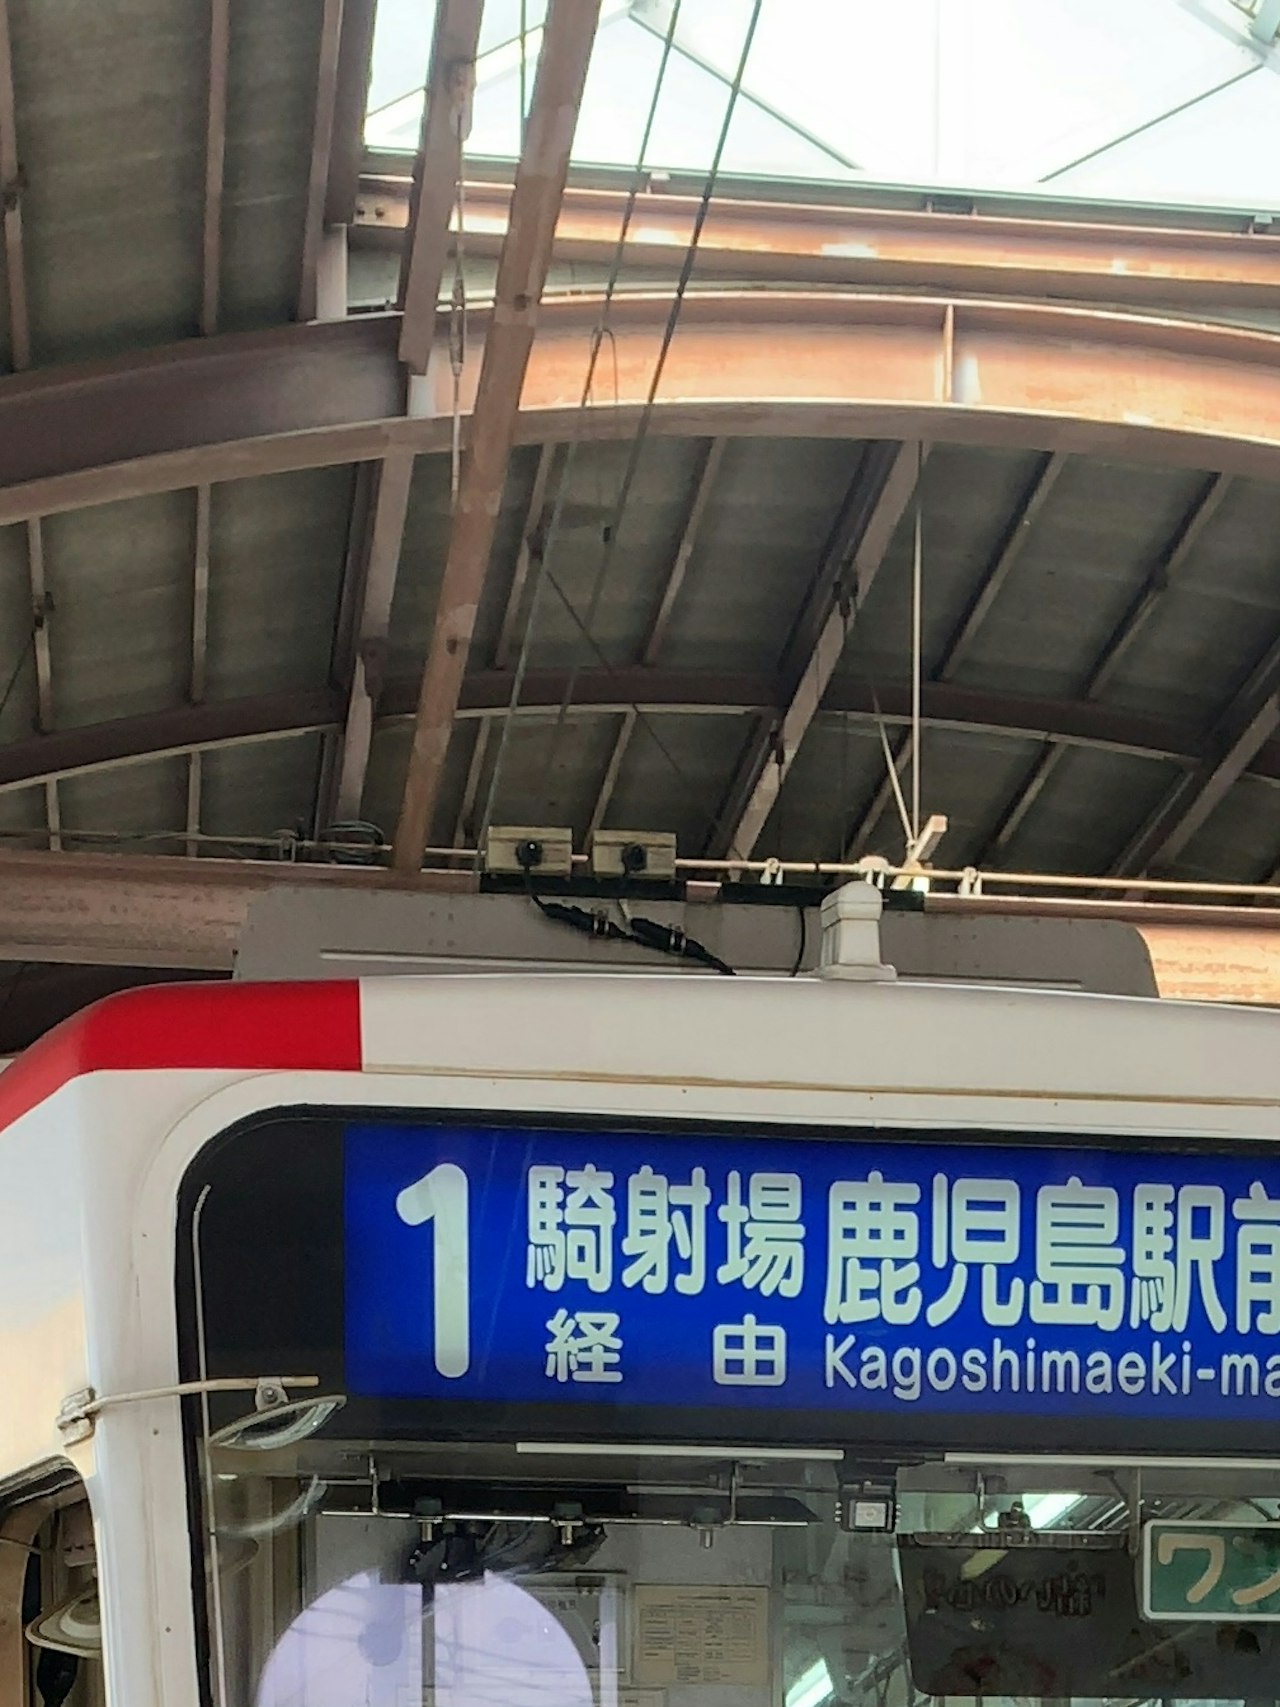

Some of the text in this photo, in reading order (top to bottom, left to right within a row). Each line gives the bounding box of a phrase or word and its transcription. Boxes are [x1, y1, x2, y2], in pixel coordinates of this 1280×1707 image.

[395, 1162, 471, 1380] 1
[526, 1163, 805, 1299] 騎射場
